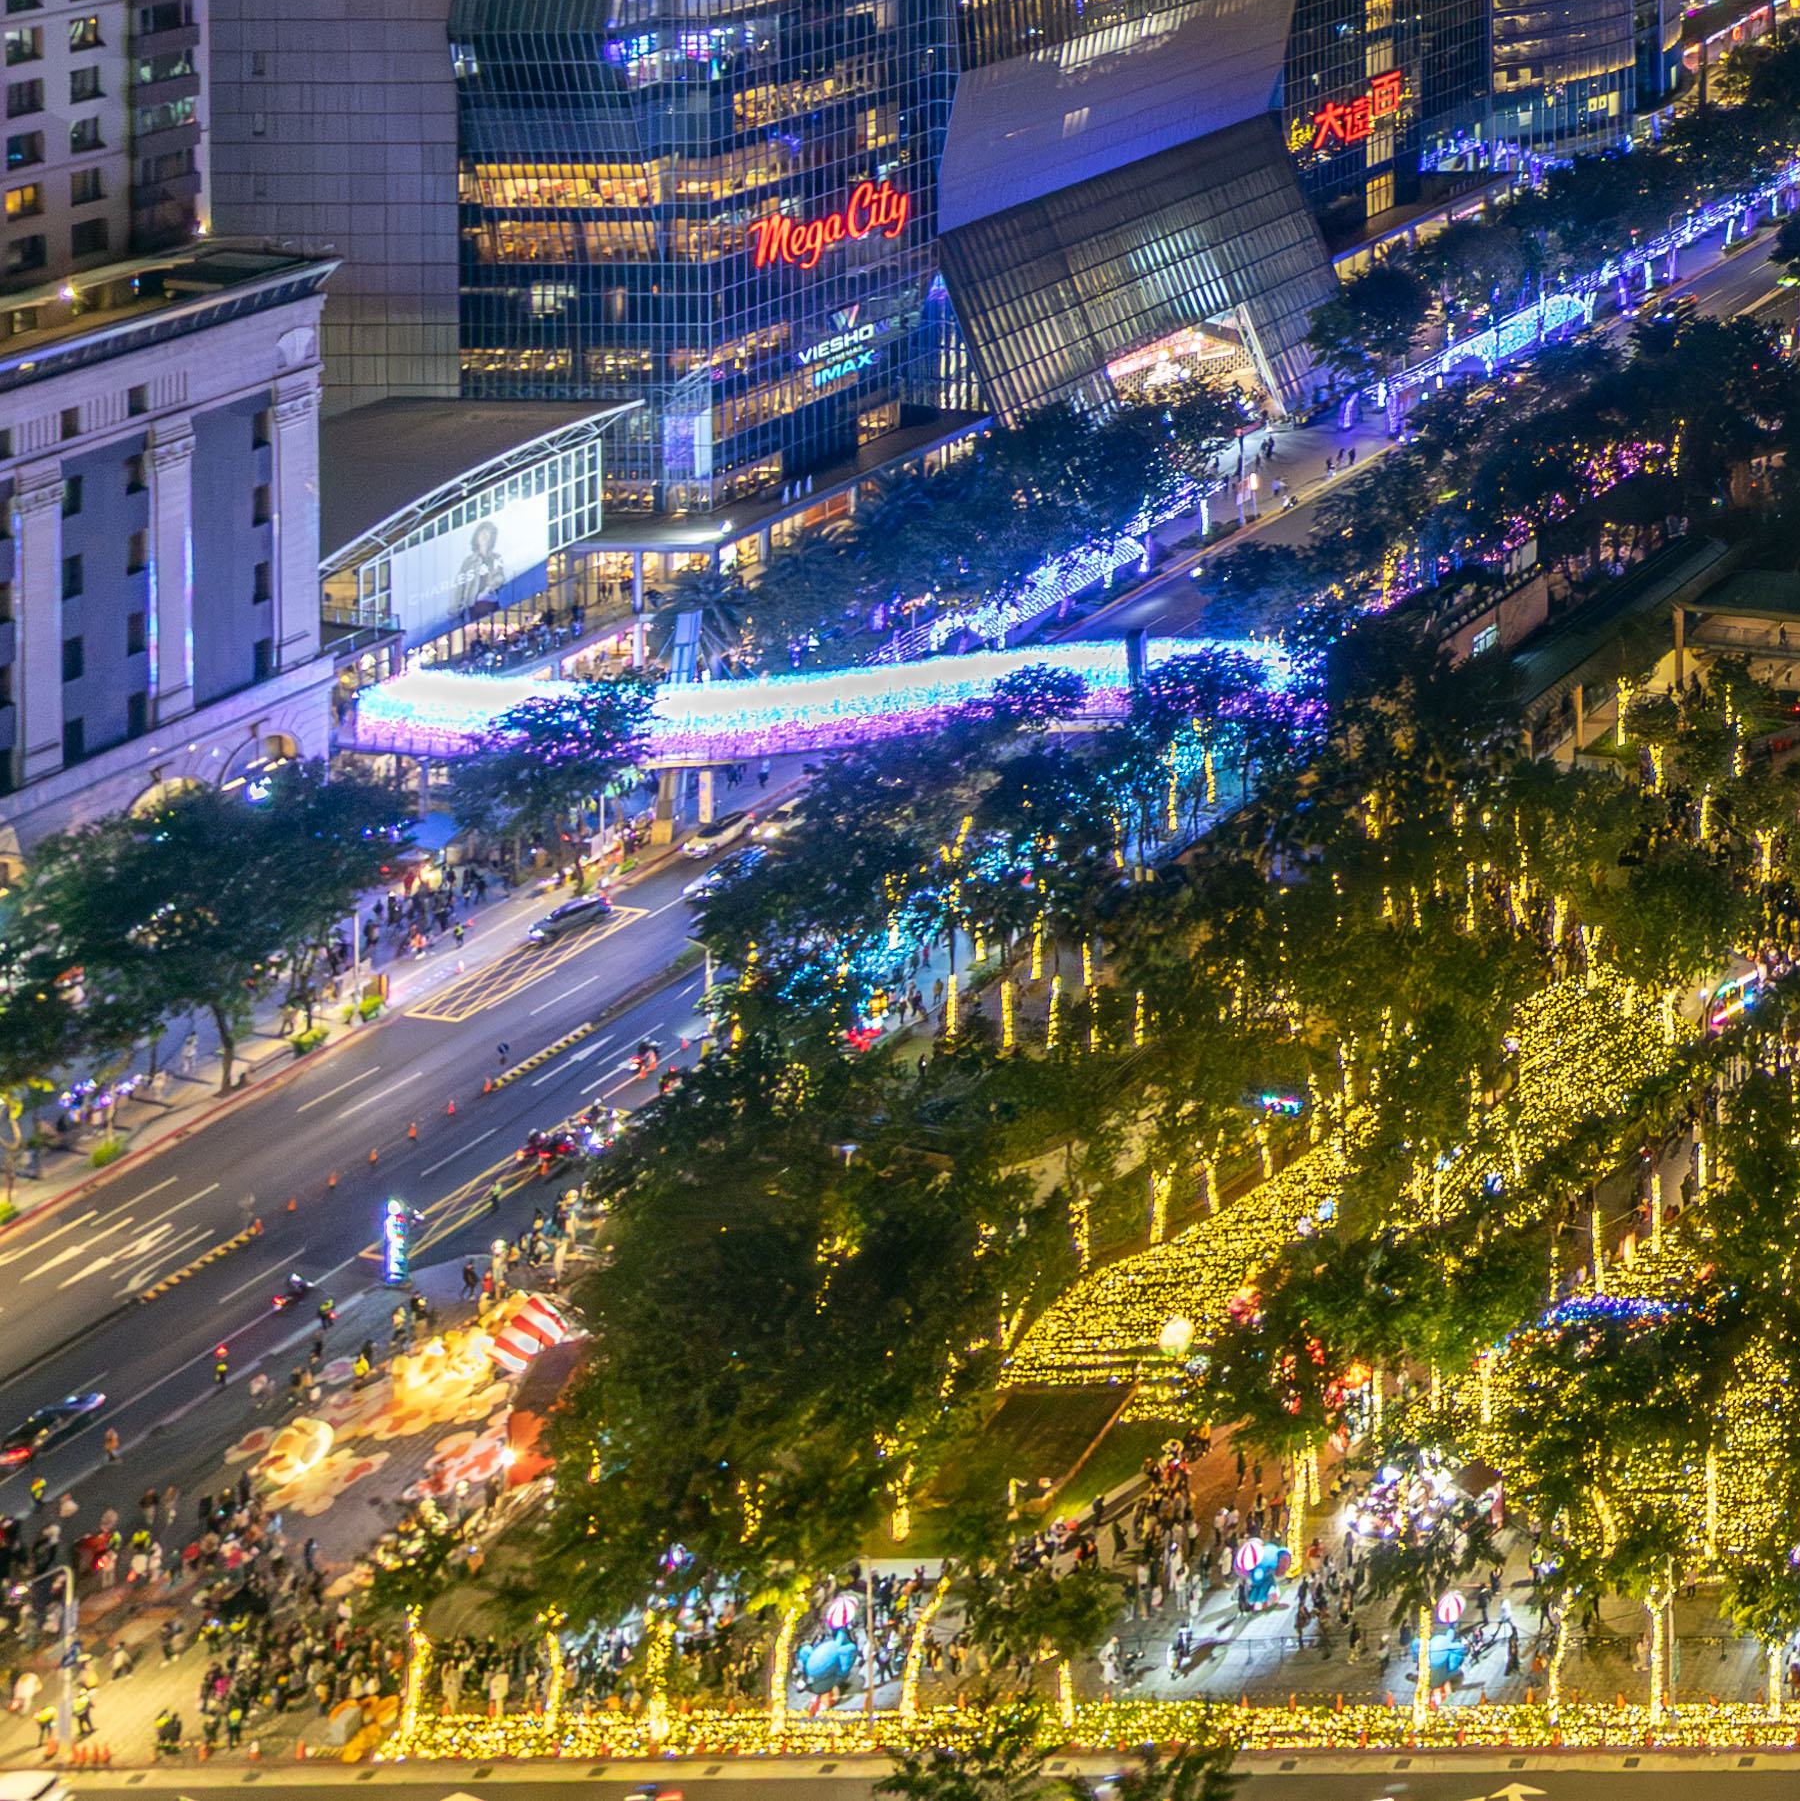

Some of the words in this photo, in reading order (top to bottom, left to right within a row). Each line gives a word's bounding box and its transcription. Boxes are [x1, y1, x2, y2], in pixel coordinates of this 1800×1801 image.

[1313, 70, 1402, 150] 大遠百
[748, 213, 846, 269] Mega
[847, 180, 909, 239] City
[814, 351, 873, 387] IMAX
